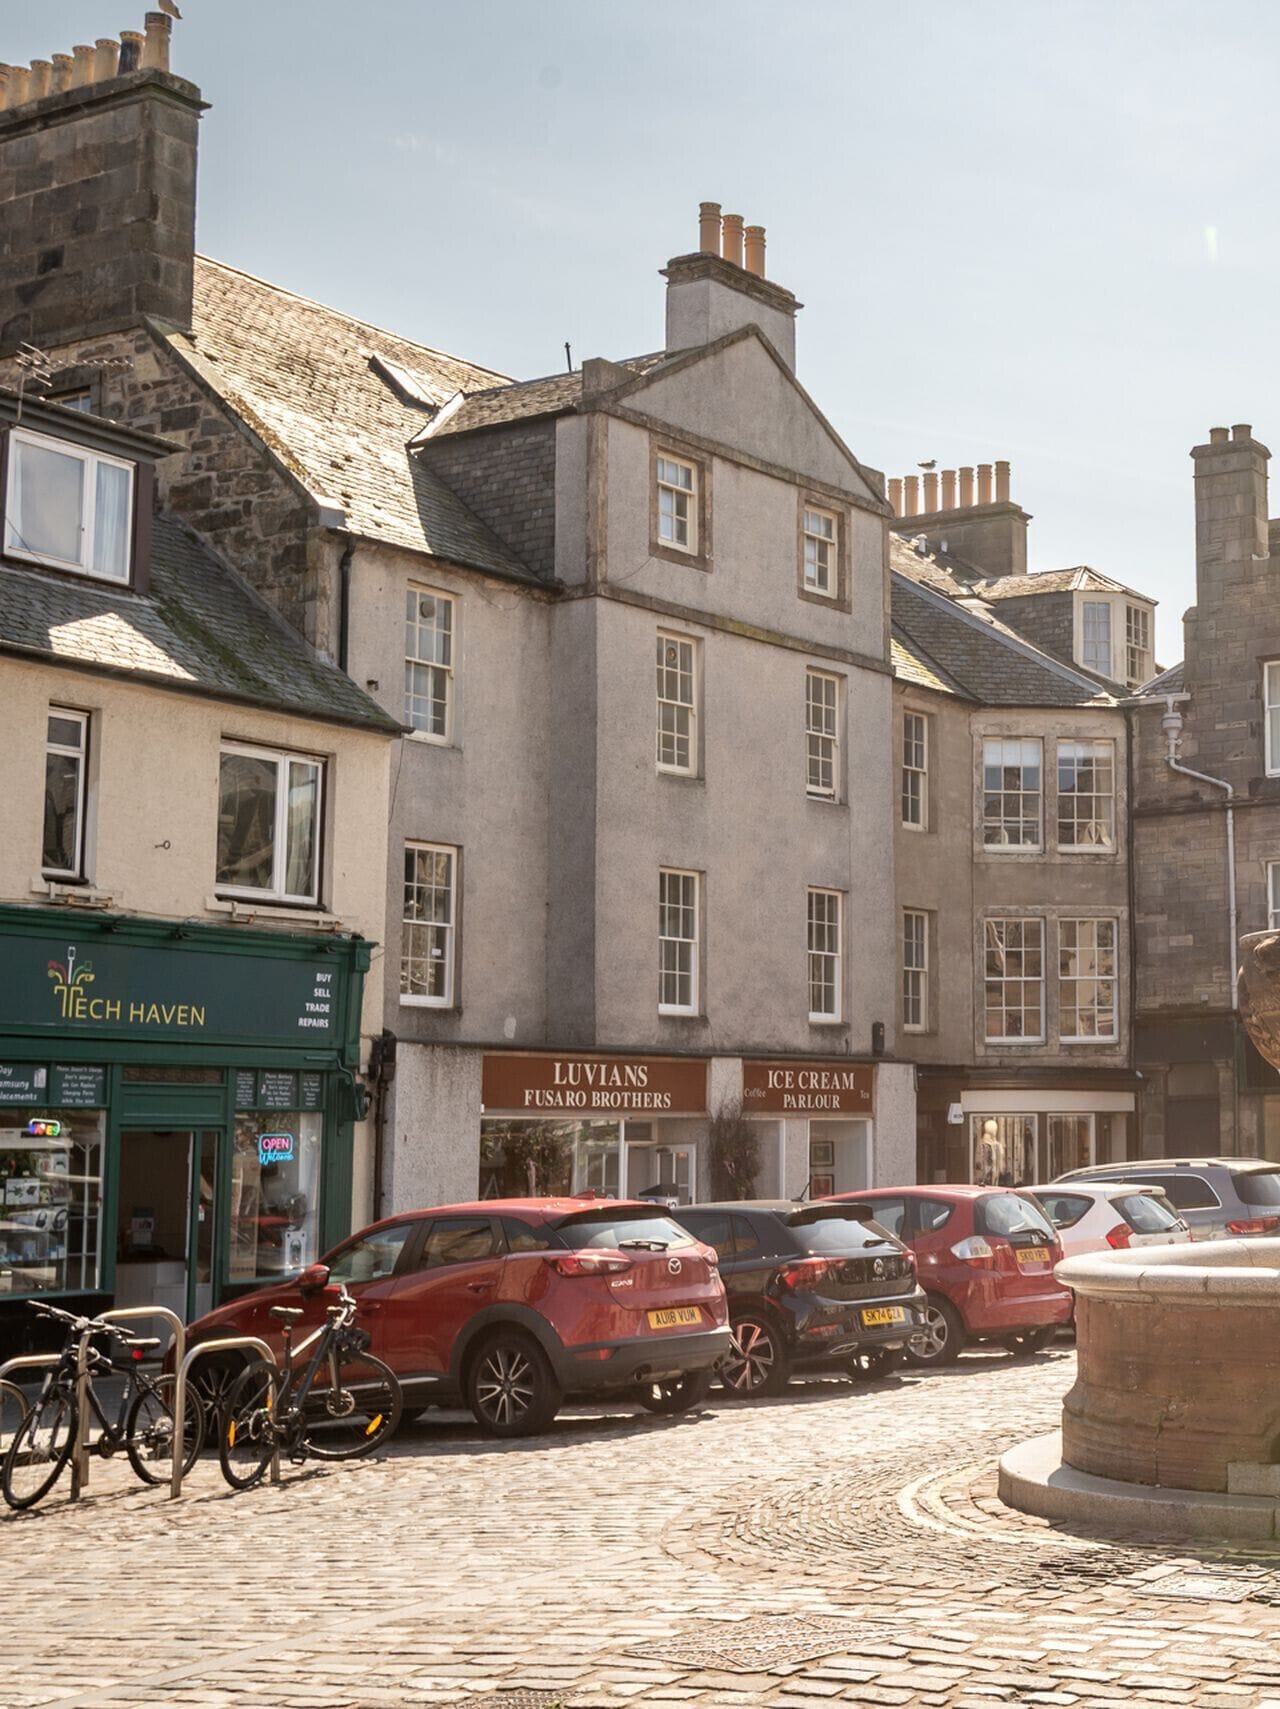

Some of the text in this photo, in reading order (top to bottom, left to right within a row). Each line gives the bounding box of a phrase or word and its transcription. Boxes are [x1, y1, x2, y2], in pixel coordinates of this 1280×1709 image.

[316, 973, 332, 982] BUY
[314, 988, 331, 997] SELL
[54, 985, 205, 1026] TECH HAVEN
[305, 1002, 330, 1013] TRADE
[298, 1017, 329, 1028] REPAIRS
[553, 1062, 648, 1087] LUVIANS
[768, 1070, 855, 1090] ICE CREAM
[0, 1080, 29, 1091] amsung
[0, 1091, 37, 1101] lacements
[524, 1089, 671, 1108] FUSARO BROTHERS
[744, 1088, 766, 1098] Coffee
[860, 1090, 869, 1099] Tea
[783, 1094, 840, 1109] PARLOUR
[262, 1138, 289, 1150] OPEN
